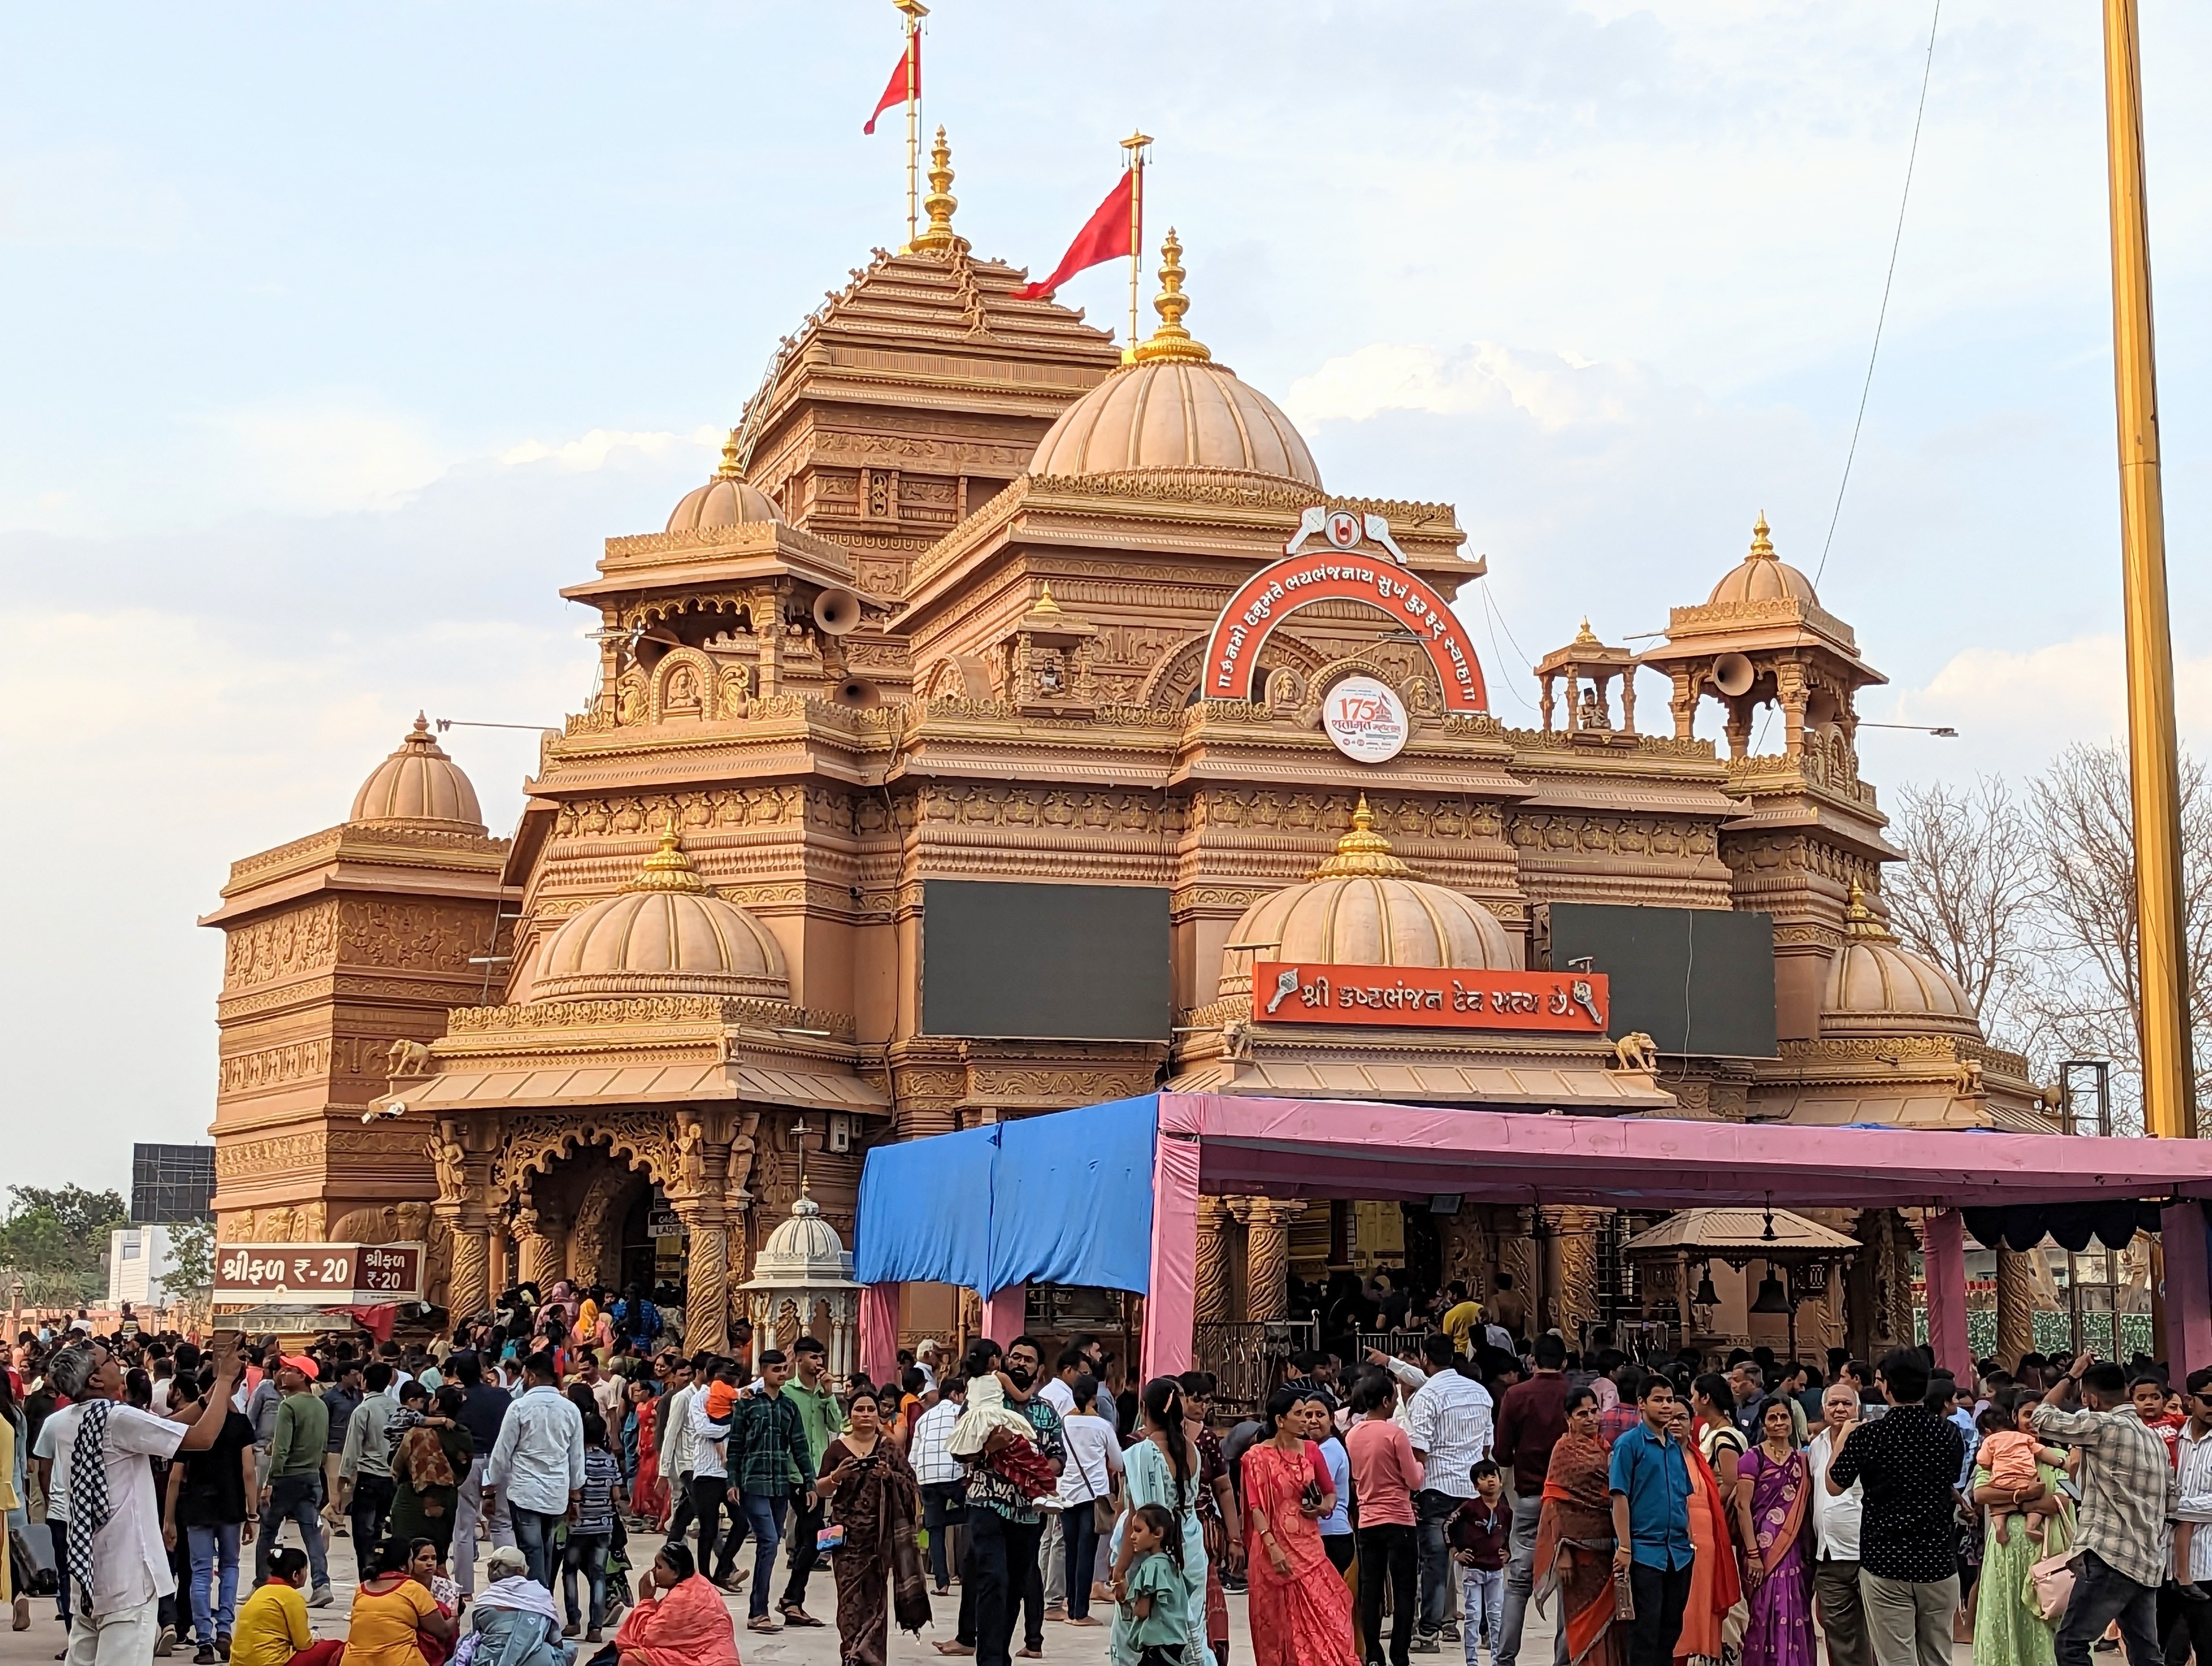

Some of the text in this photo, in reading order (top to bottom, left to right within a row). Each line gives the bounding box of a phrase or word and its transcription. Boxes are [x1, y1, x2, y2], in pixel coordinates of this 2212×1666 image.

[1243, 581, 1285, 625] હનુમતે
[1285, 564, 1374, 591] ભયભંજનાય
[1378, 575, 1410, 598] સુખં
[1338, 698, 1377, 720] 175
[1301, 976, 1574, 1016] શ્રી કષ્ટભંજન દેવ સત્ય છે.
[221, 1250, 285, 1285] શ્રીફળ
[365, 1250, 405, 1269] શ્રીફળ
